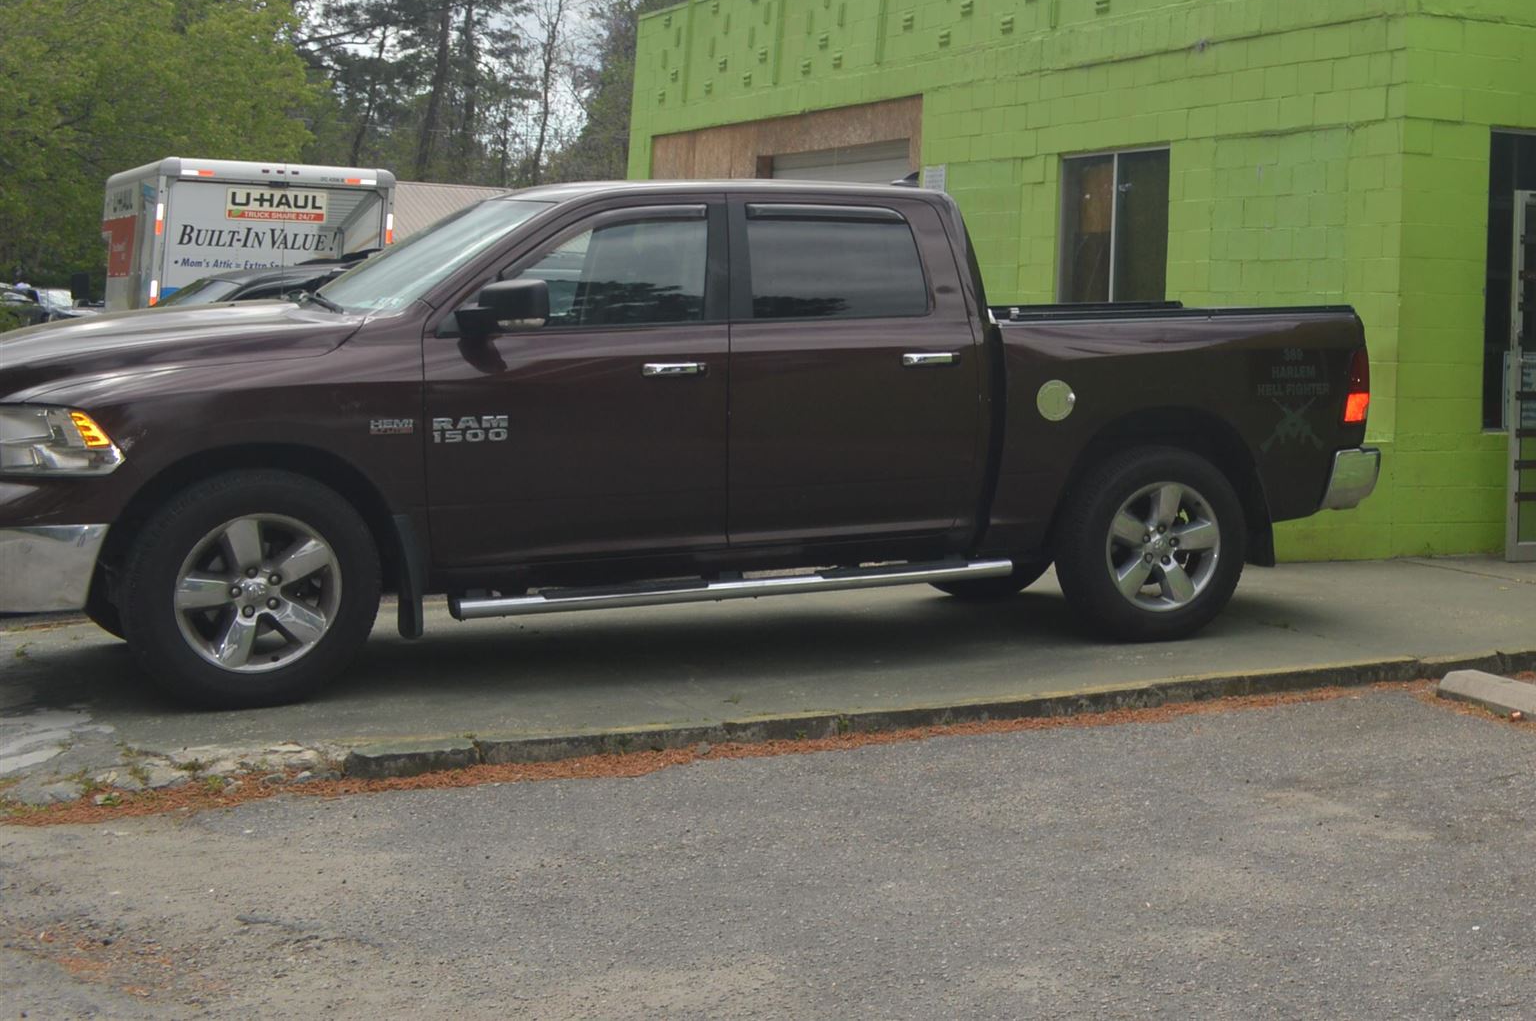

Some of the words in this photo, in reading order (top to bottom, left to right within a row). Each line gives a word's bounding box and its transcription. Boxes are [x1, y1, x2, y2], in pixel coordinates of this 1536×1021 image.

[231, 191, 323, 210] U-HAUL
[244, 210, 270, 219] TRUCK
[271, 212, 297, 220] SHARE
[298, 213, 315, 221] 24/7
[177, 224, 266, 249] BUILT-IN
[180, 257, 210, 268] Mom's
[212, 258, 233, 269] Attic
[1271, 364, 1316, 379] HARLEM
[1256, 383, 1284, 397] HELL
[1286, 382, 1330, 396] FIGHTER
[370, 418, 414, 429] HEMI
[432, 415, 509, 429] RAM
[432, 429, 508, 443] 1500
